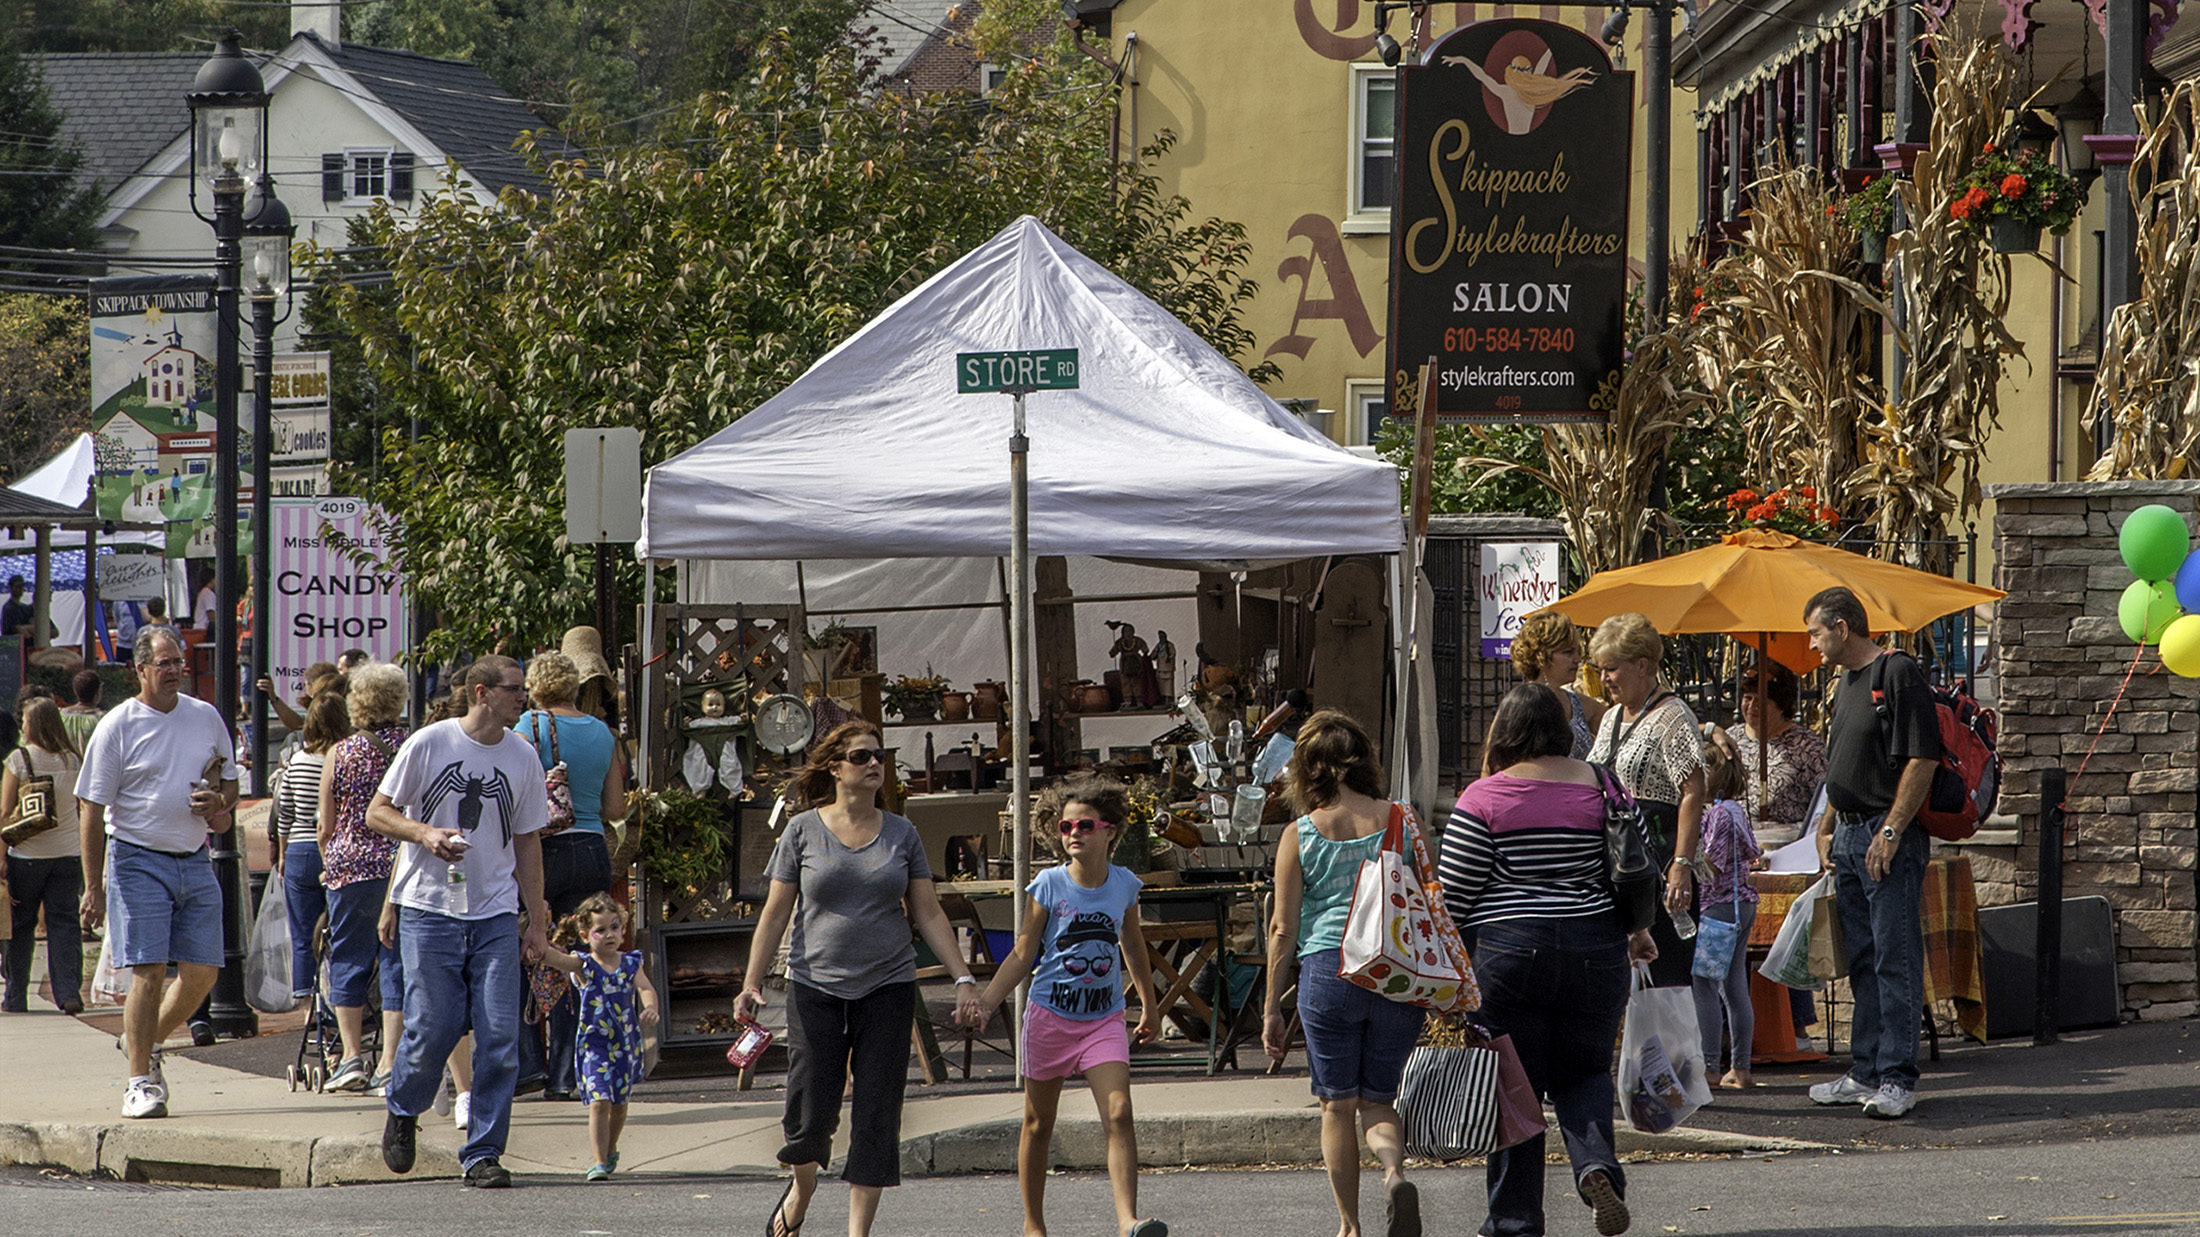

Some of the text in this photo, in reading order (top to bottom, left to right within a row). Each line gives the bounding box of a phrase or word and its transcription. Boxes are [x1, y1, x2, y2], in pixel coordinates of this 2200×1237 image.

[1429, 119, 1571, 212] Skippack
[97, 291, 209, 313] SKIPPACK TOWNSHIP
[1452, 282, 1572, 313] SALON
[1444, 327, 1574, 352] 610-584-7840
[966, 356, 1075, 387] STORE RD
[1440, 365, 1575, 391] stylekrafters.com
[291, 372, 327, 398] CURDS
[1495, 395, 1521, 409] 4019
[320, 503, 356, 513] 4019
[277, 571, 396, 595] CANDY
[293, 613, 387, 638] SHOP
[1049, 981, 1114, 1013] NEW YORK
